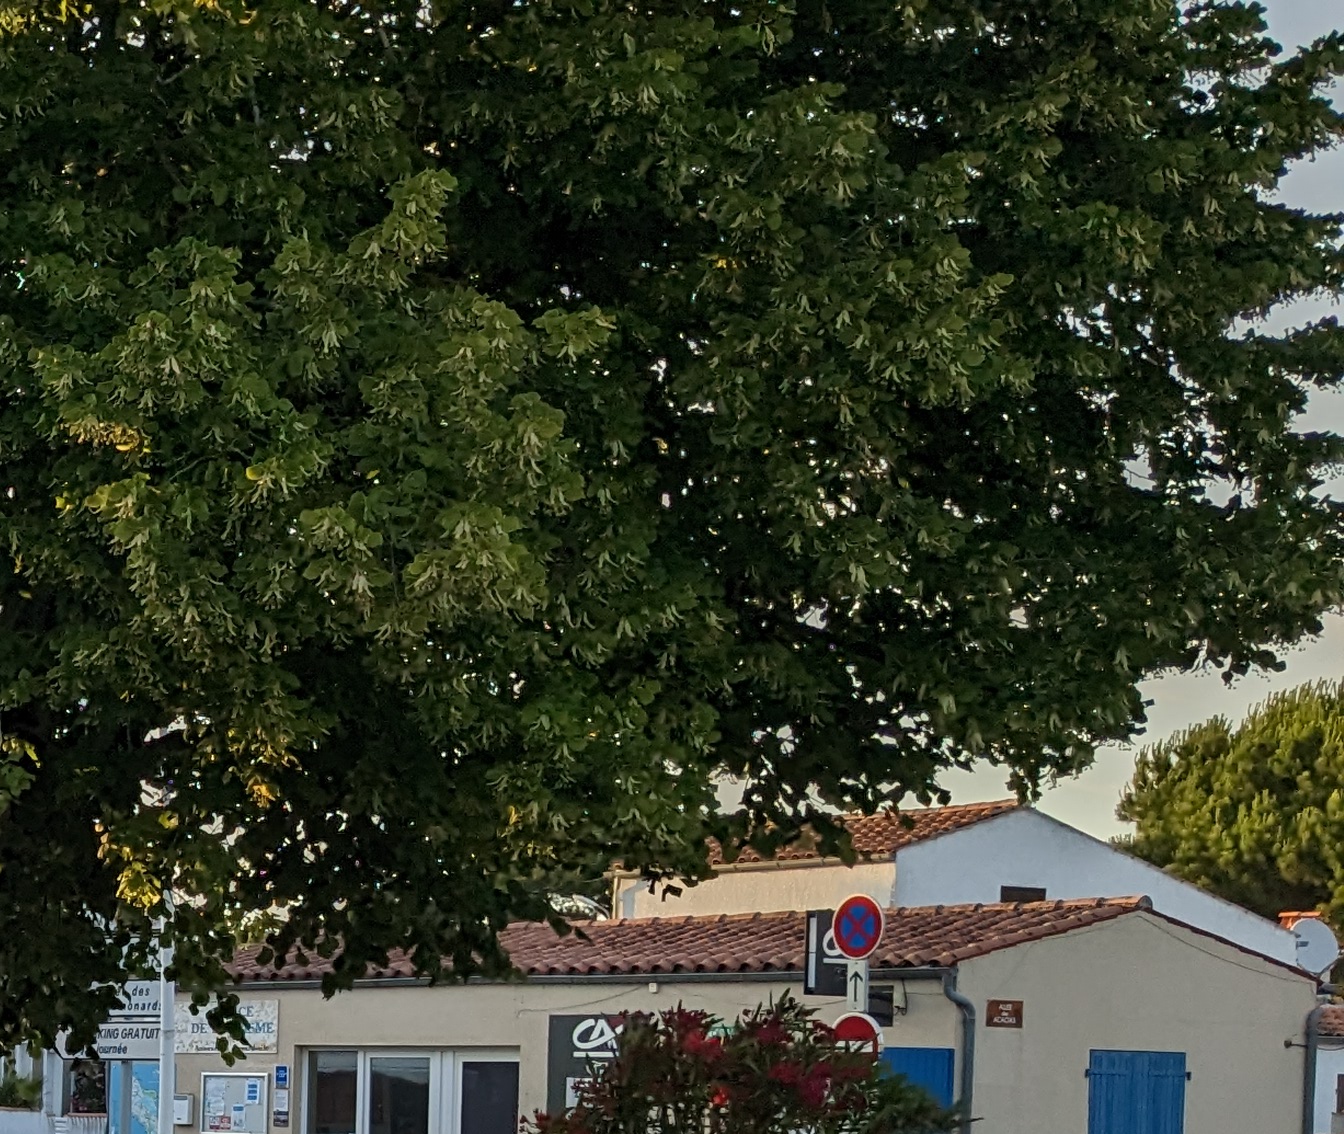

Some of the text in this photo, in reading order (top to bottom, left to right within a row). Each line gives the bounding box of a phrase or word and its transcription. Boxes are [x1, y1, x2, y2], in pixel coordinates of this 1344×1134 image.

[131, 986, 150, 997] des
[97, 1028, 161, 1040] KING GRATUIT
[191, 1022, 208, 1034] DE
